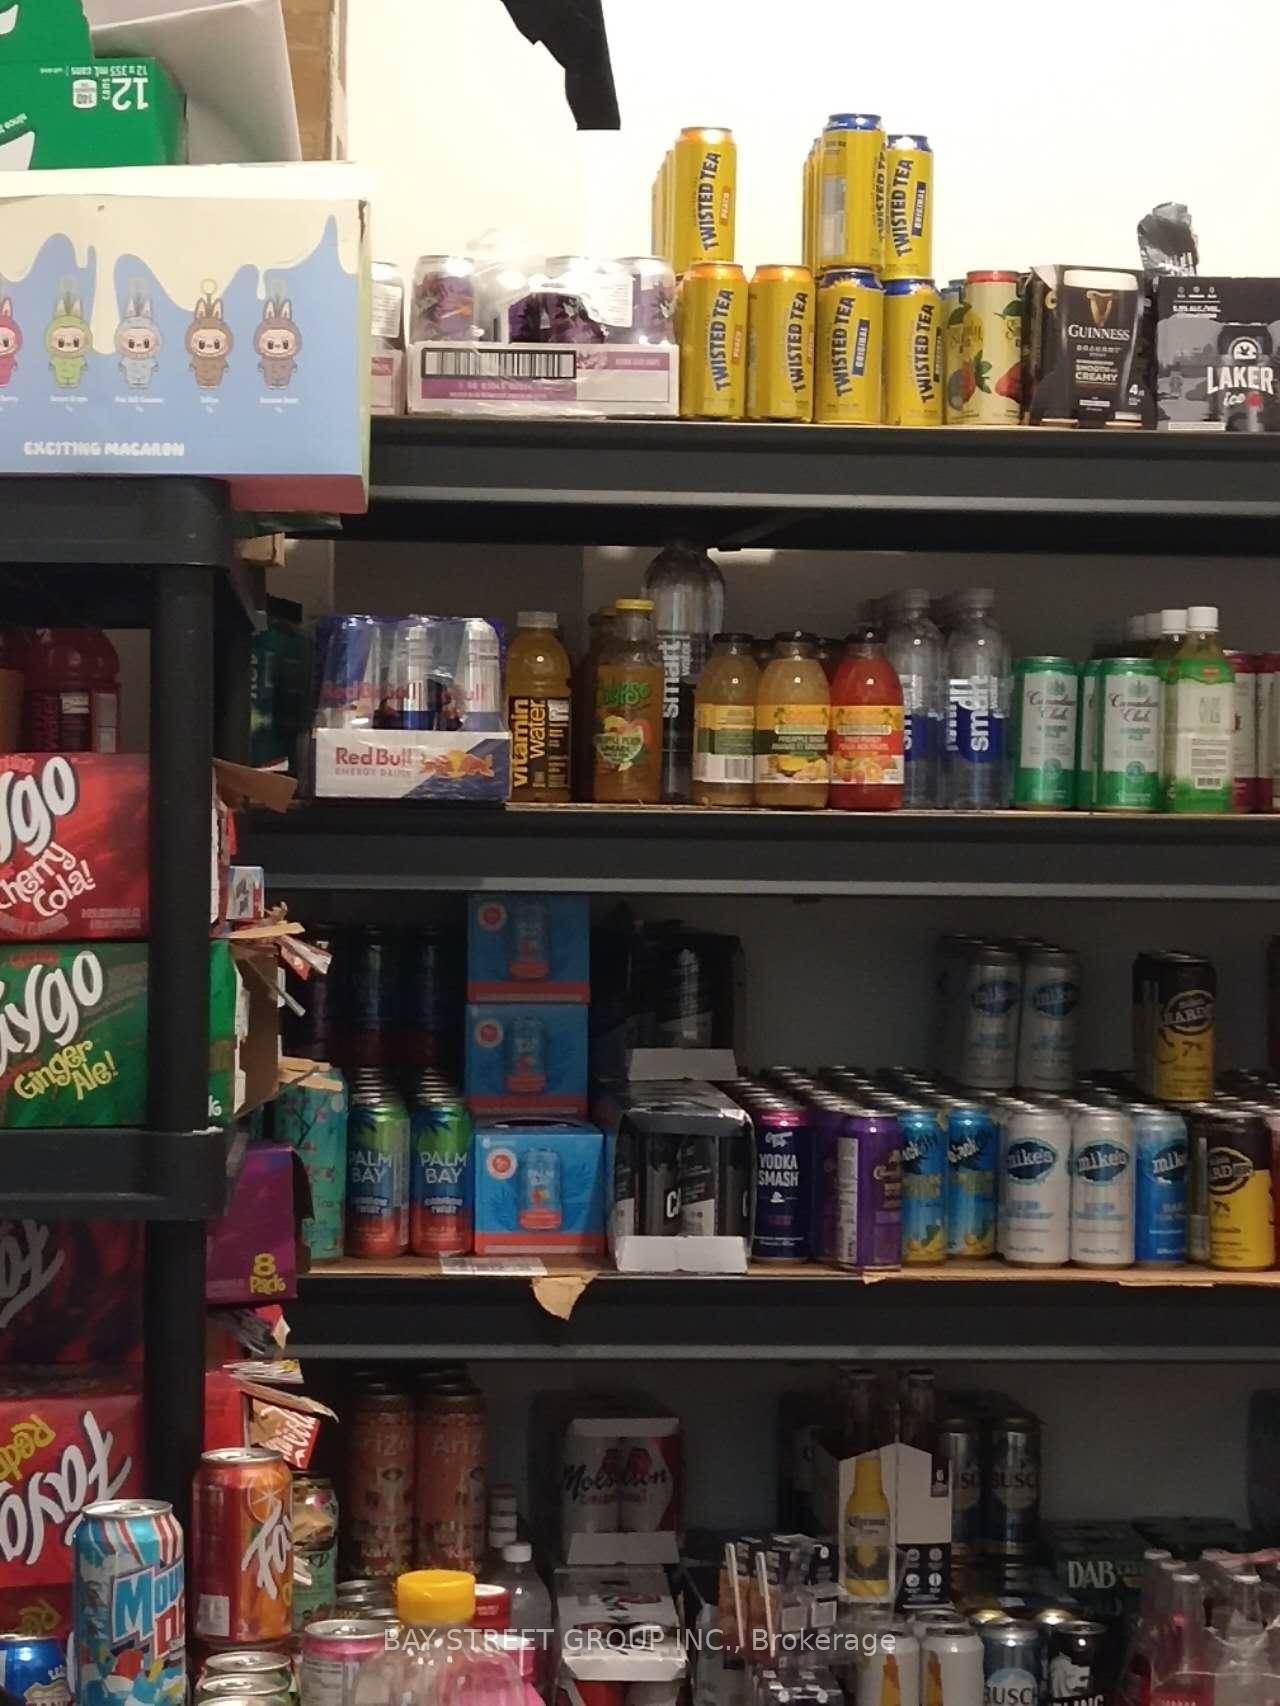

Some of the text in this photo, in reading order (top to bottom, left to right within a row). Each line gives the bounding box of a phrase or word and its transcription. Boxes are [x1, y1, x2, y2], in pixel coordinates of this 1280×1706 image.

[111, 77, 149, 110] 12
[698, 152, 722, 251] TWISTED TEA
[890, 158, 914, 257] TWISTED TEA
[708, 288, 735, 392] TWISTED TEA
[785, 291, 809, 394] TWISTED TEA
[831, 295, 856, 398] TWISTED TEA
[1067, 323, 1131, 341] GUINNESS
[912, 302, 937, 404] TWISTED TEA
[1074, 371, 1119, 383] CREAMY
[1206, 365, 1275, 395] LAKER
[23, 441, 185, 456] EXCITING MACARON
[661, 641, 681, 719] smart
[511, 698, 529, 788] vitamin
[529, 699, 546, 759] water
[335, 746, 414, 767] Red Bull
[0, 841, 76, 910] herry
[32, 859, 97, 917] Cola!
[14, 1039, 94, 1100] Ginger
[71, 1050, 119, 1101] Ale!
[350, 1150, 393, 1169] PALM
[420, 1150, 468, 1168] PALM
[758, 1153, 799, 1171] VODKA
[1078, 1150, 1127, 1171] mike's
[350, 1167, 387, 1185] BAY
[424, 1168, 464, 1184] BAY
[757, 1169, 800, 1188] SMASH
[252, 1253, 277, 1276] 8
[250, 1274, 287, 1294] Pack
[1067, 1560, 1117, 1589] DAB
